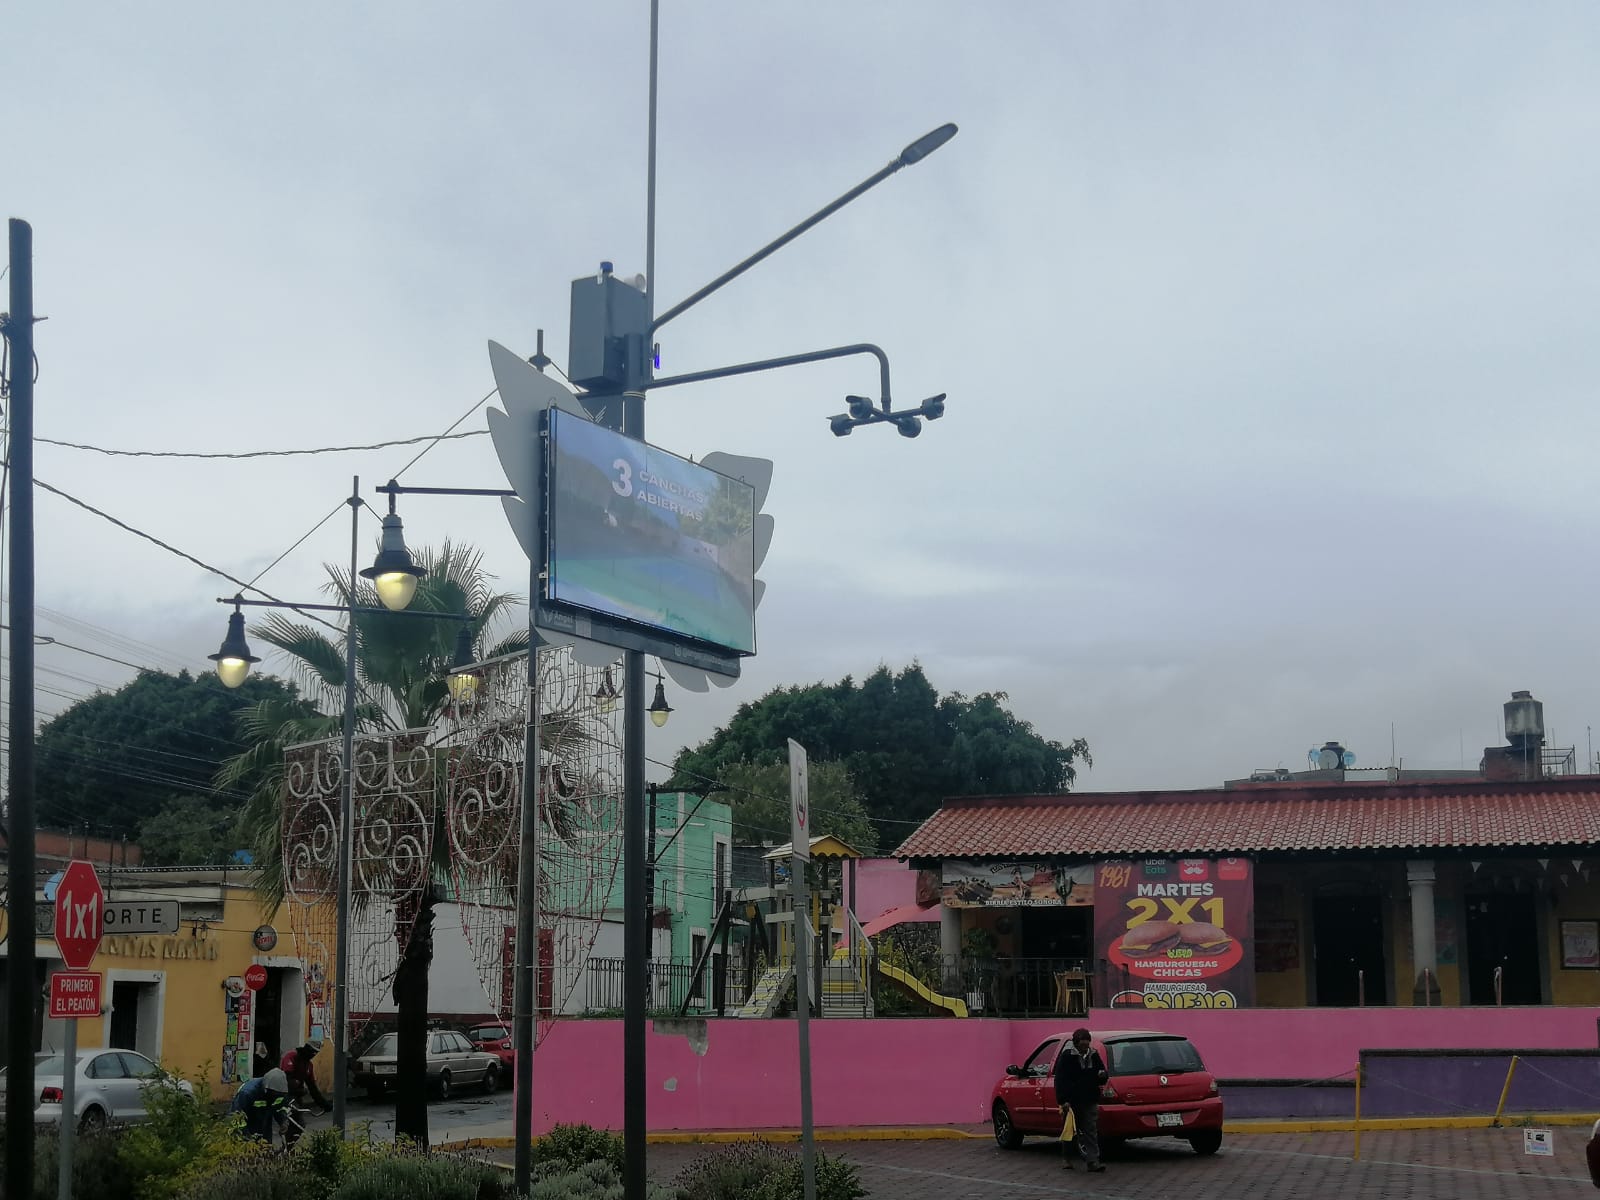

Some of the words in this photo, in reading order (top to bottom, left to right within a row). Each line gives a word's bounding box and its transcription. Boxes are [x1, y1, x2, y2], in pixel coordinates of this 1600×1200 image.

[612, 458, 633, 497] 3
[639, 470, 704, 503] CANCHAS
[637, 490, 704, 522] ABIERTAS
[1145, 866, 1167, 874] Eats
[1137, 882, 1214, 897] MARTES
[103, 908, 163, 926] ORTE
[1126, 898, 1224, 930] 2X1
[1135, 960, 1218, 968] HAMBURGUESAS
[1152, 969, 1203, 977] CHICAS
[60, 978, 94, 993] PRIMERO
[1145, 983, 1206, 993] HAMBURGUESAS
[56, 998, 66, 1012] EL
[68, 994, 96, 1012] PEATÓN
